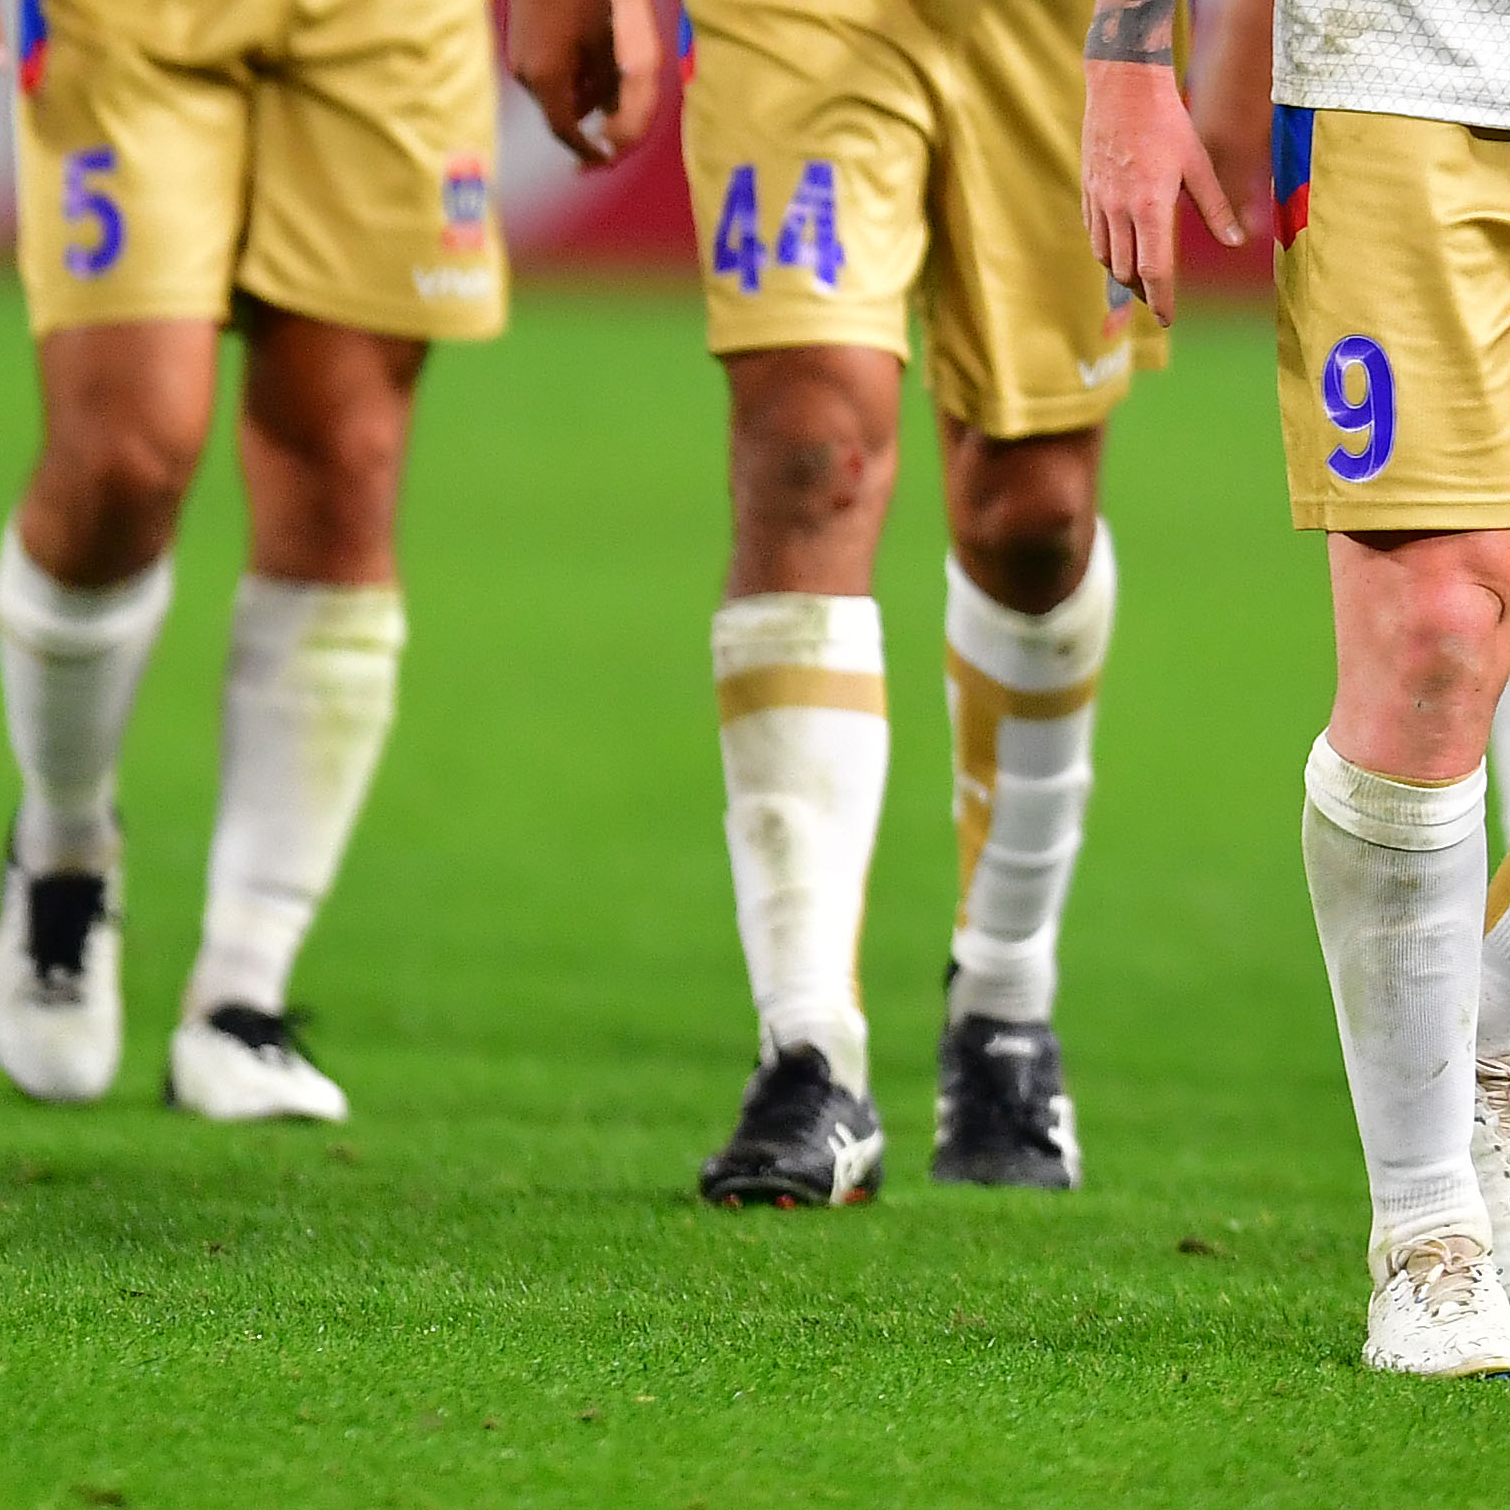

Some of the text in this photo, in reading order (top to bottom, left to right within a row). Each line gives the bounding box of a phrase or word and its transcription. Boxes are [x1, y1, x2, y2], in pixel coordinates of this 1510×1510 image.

[62, 145, 127, 279] 5
[714, 159, 845, 294] 44
[1321, 334, 1397, 483] 9
